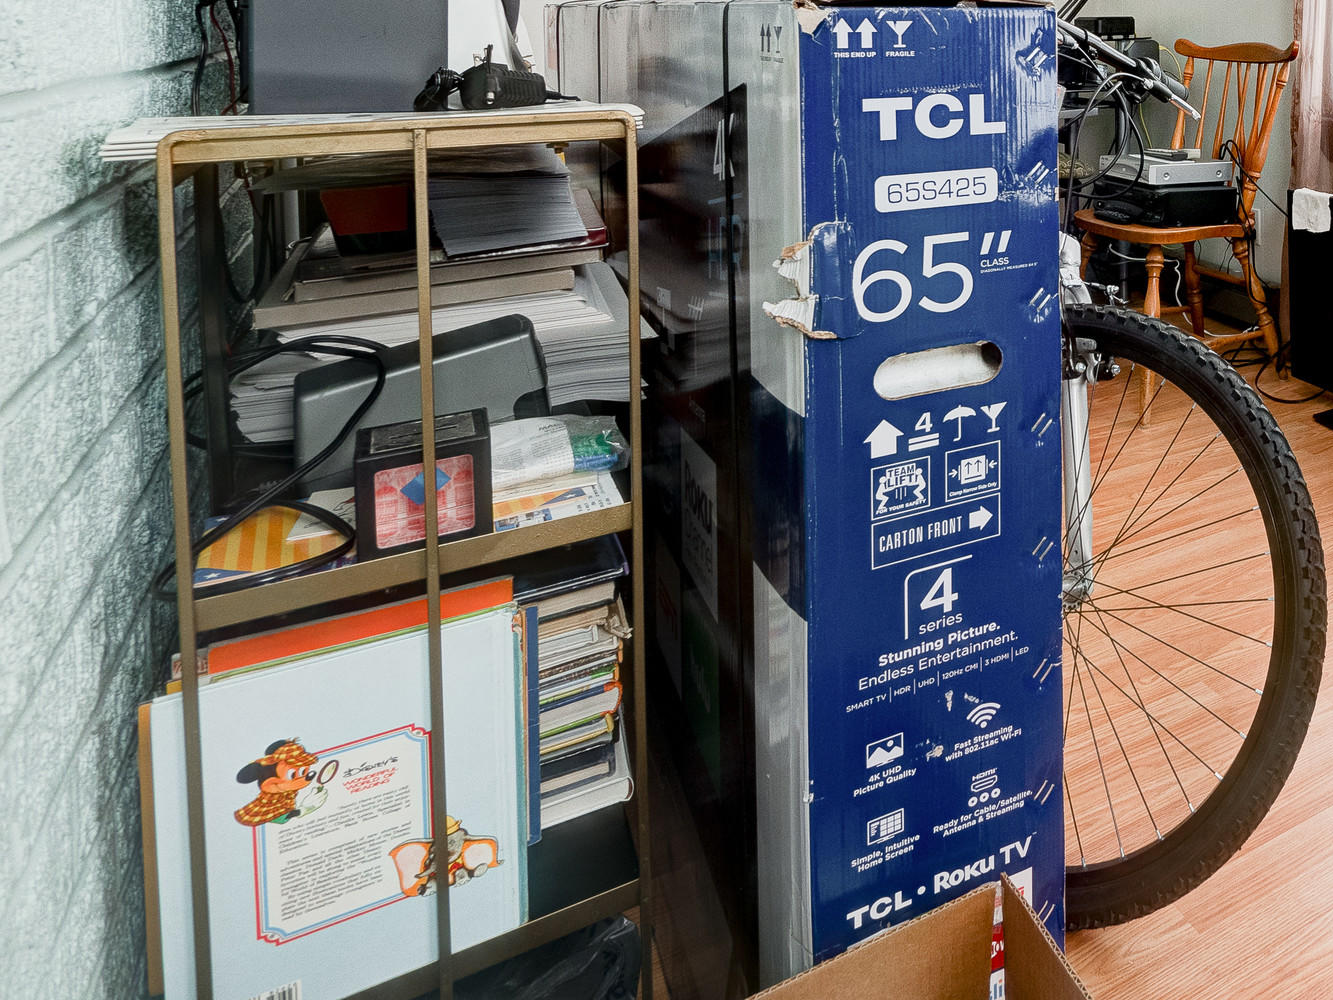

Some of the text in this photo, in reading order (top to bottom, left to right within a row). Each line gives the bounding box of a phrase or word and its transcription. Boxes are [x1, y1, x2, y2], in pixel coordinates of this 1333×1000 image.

[886, 50, 916, 58] FRAGILE
[862, 93, 1006, 141] TCL
[886, 175, 987, 205] 65S425
[980, 256, 1010, 268] CLASS
[914, 411, 933, 433] 4
[888, 464, 915, 477] TEAM
[889, 504, 904, 512] YOUR
[905, 498, 926, 508] SAFETY
[879, 516, 962, 552] CARTON FRONT
[920, 568, 959, 613] 4
[918, 612, 963, 635] series
[858, 630, 1018, 691] Endless Entertainment.
[878, 622, 1000, 667] Stunning Picture.
[846, 698, 874, 713] SMART
[876, 693, 887, 702] TV
[894, 685, 912, 697] HDR
[918, 677, 935, 688] UHD
[942, 668, 964, 680] 120Hz
[964, 663, 978, 673] CMI
[990, 653, 1010, 665] HDMI
[1015, 646, 1030, 657] LED
[945, 728, 1022, 762] with 802.11ac Wi-Fi
[954, 725, 1013, 751] Fast Streaming
[853, 768, 917, 798] Picture Quality
[868, 765, 902, 783] 4K UHD
[933, 790, 1032, 834] Ready for Cable/Satellite,
[942, 800, 1024, 838] Antenna & Streaming
[850, 834, 920, 868] Simple, Intuitive
[858, 844, 914, 873] Home Screen
[846, 834, 1032, 930] TCL Roku TV
